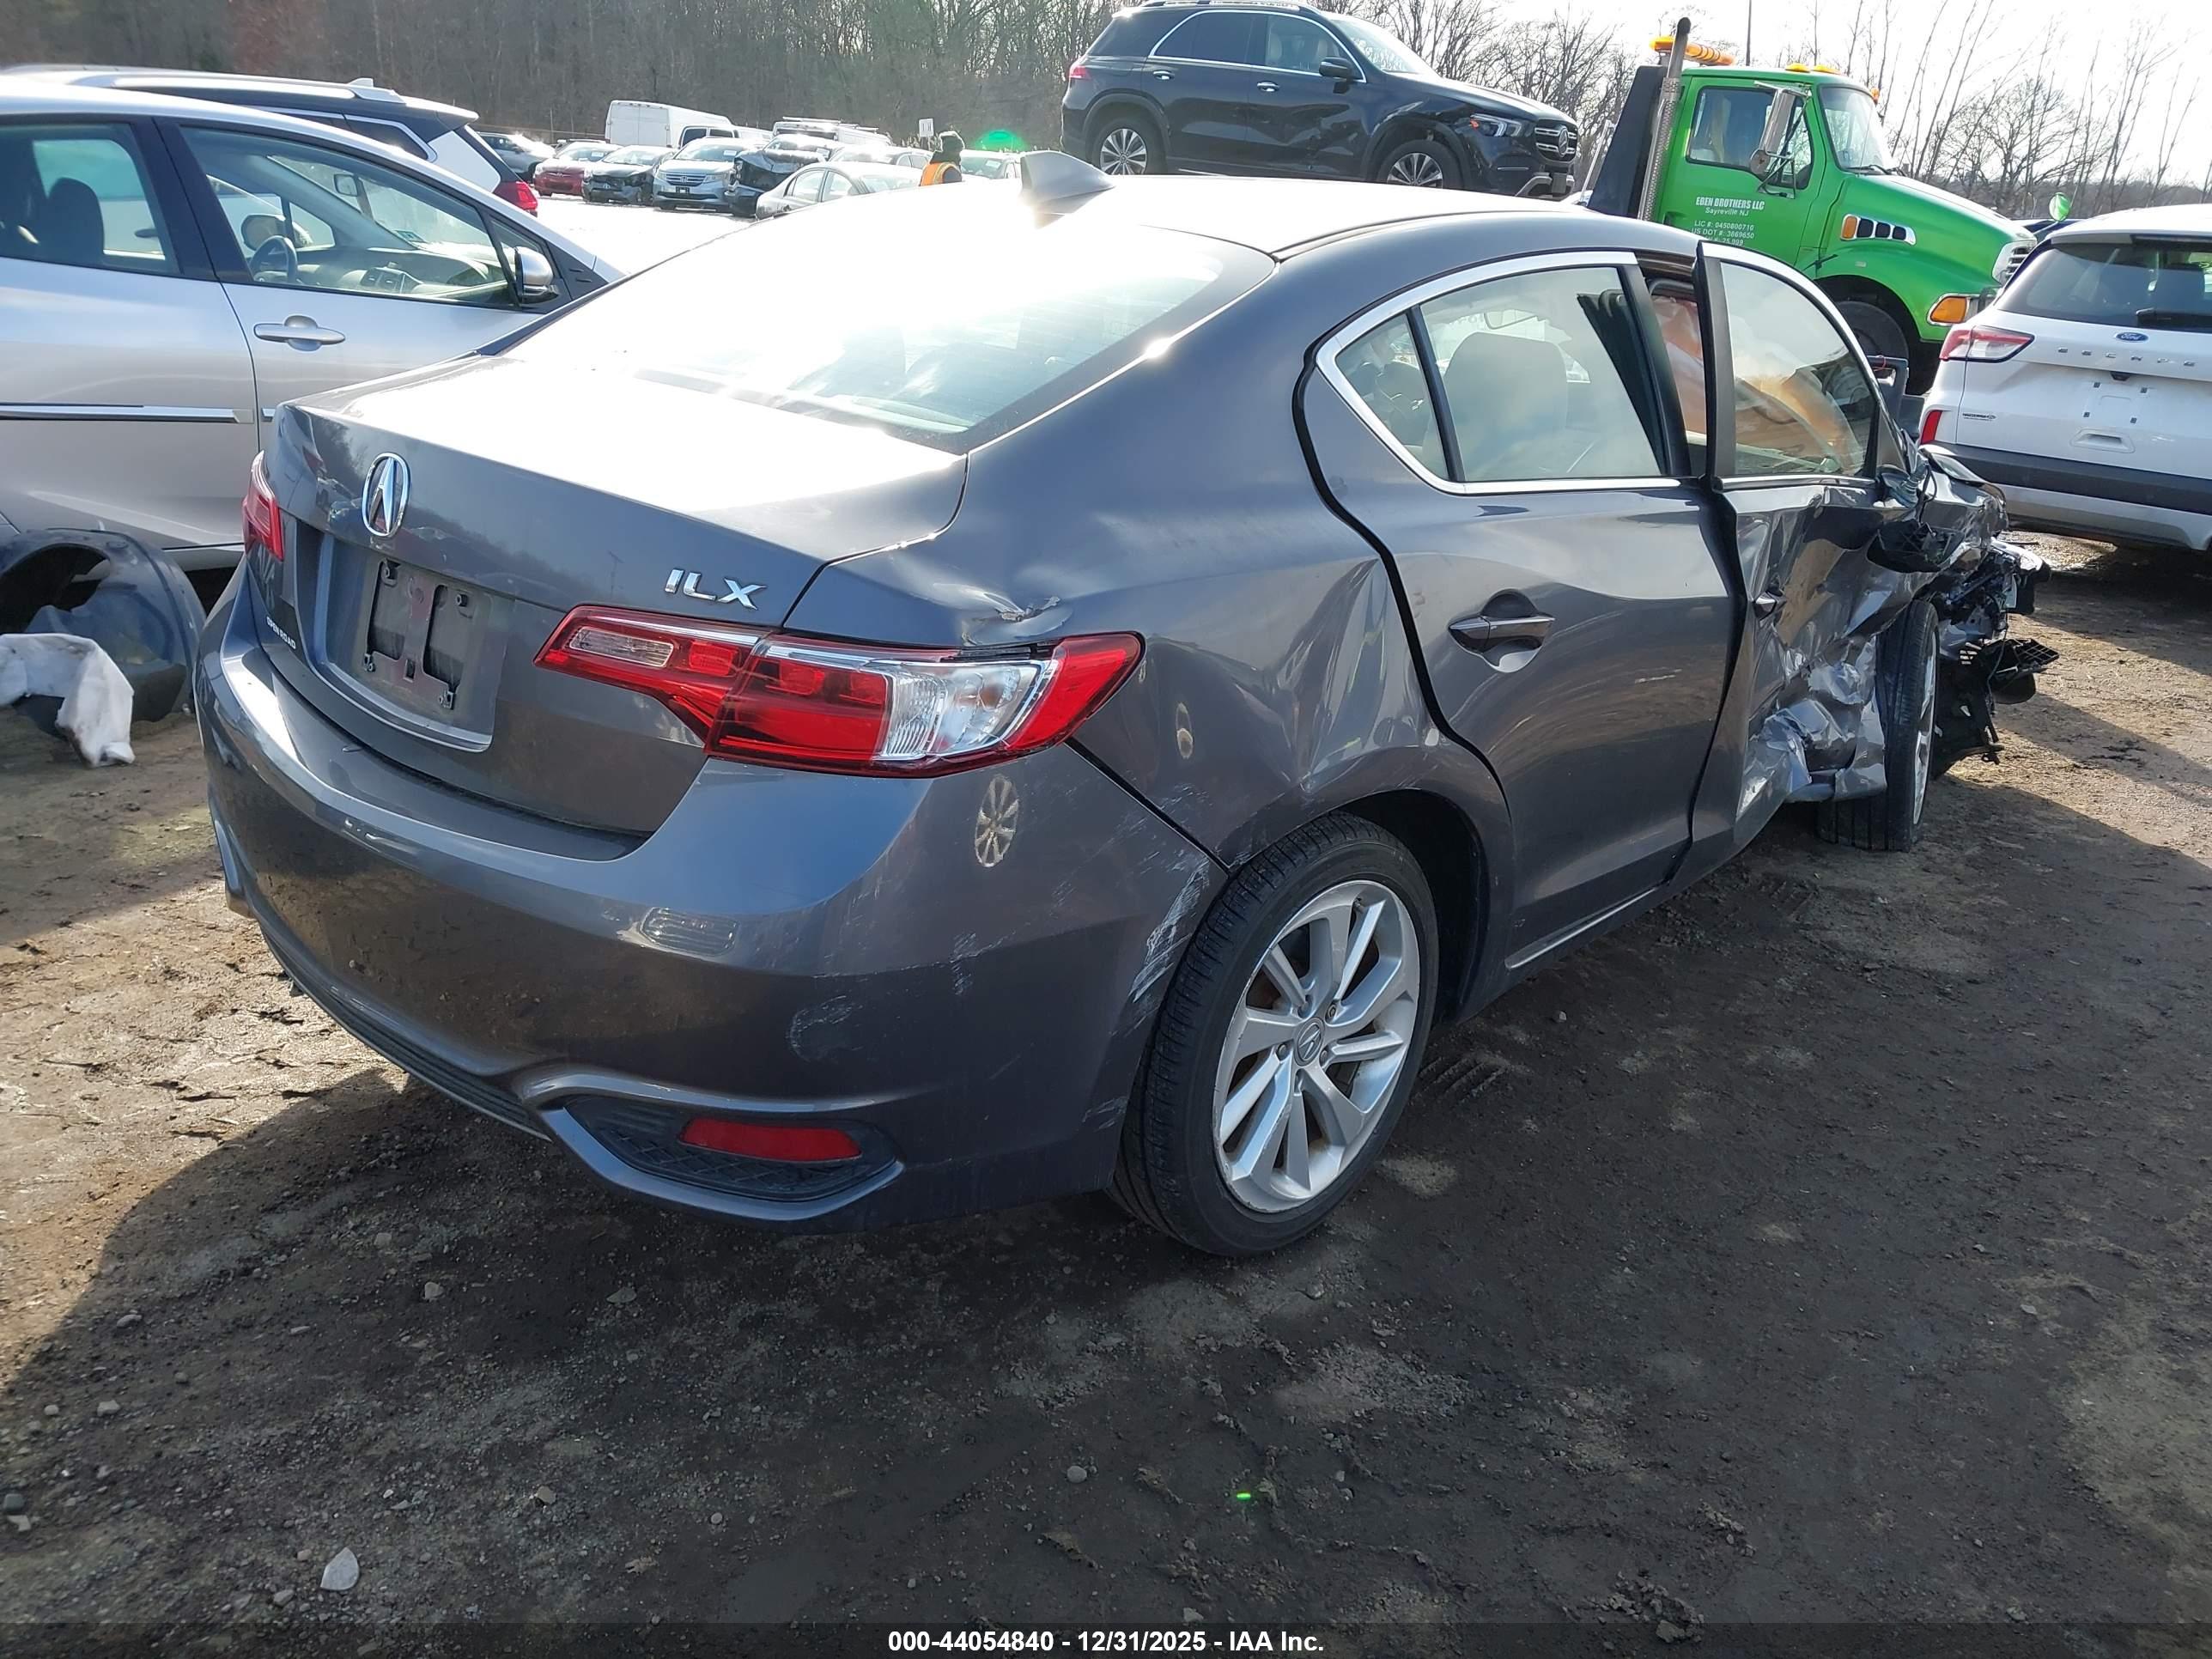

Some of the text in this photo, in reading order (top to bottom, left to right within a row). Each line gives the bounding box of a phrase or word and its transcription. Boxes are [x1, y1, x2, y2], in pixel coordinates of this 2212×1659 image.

[1696, 197, 1765, 210] EBEN BROTHERS LLC
[1705, 207, 1738, 216] Sayreville
[2119, 332, 2142, 341] Ford
[665, 568, 767, 611] ILX
[280, 629, 296, 650] ROAD
